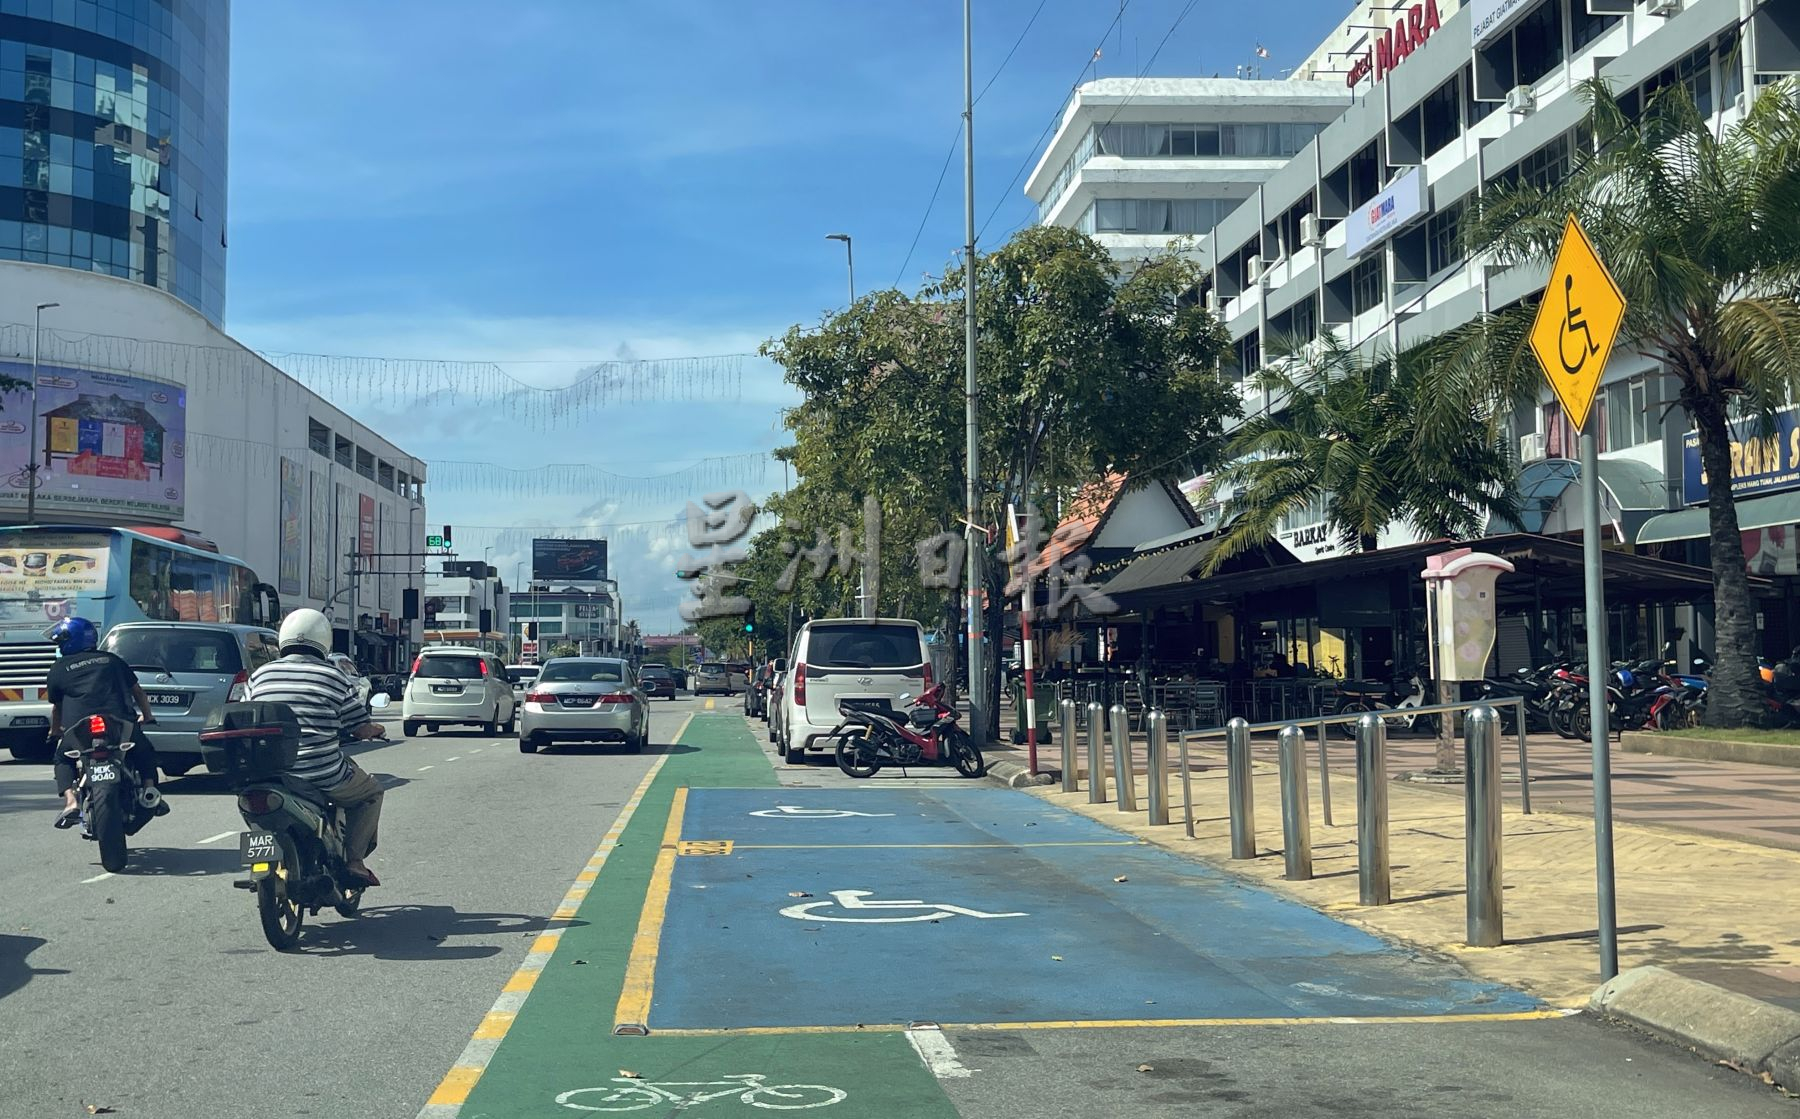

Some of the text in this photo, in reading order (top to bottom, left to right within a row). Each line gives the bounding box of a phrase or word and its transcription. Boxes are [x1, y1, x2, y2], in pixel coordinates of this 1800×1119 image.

[1473, 11, 1496, 39] PEJABAT
[1376, 0, 1440, 83] MARA
[160, 695, 180, 704] 3039
[91, 771, 116, 782] 9040
[250, 835, 273, 847] MAR
[247, 846, 275, 858] 5771
